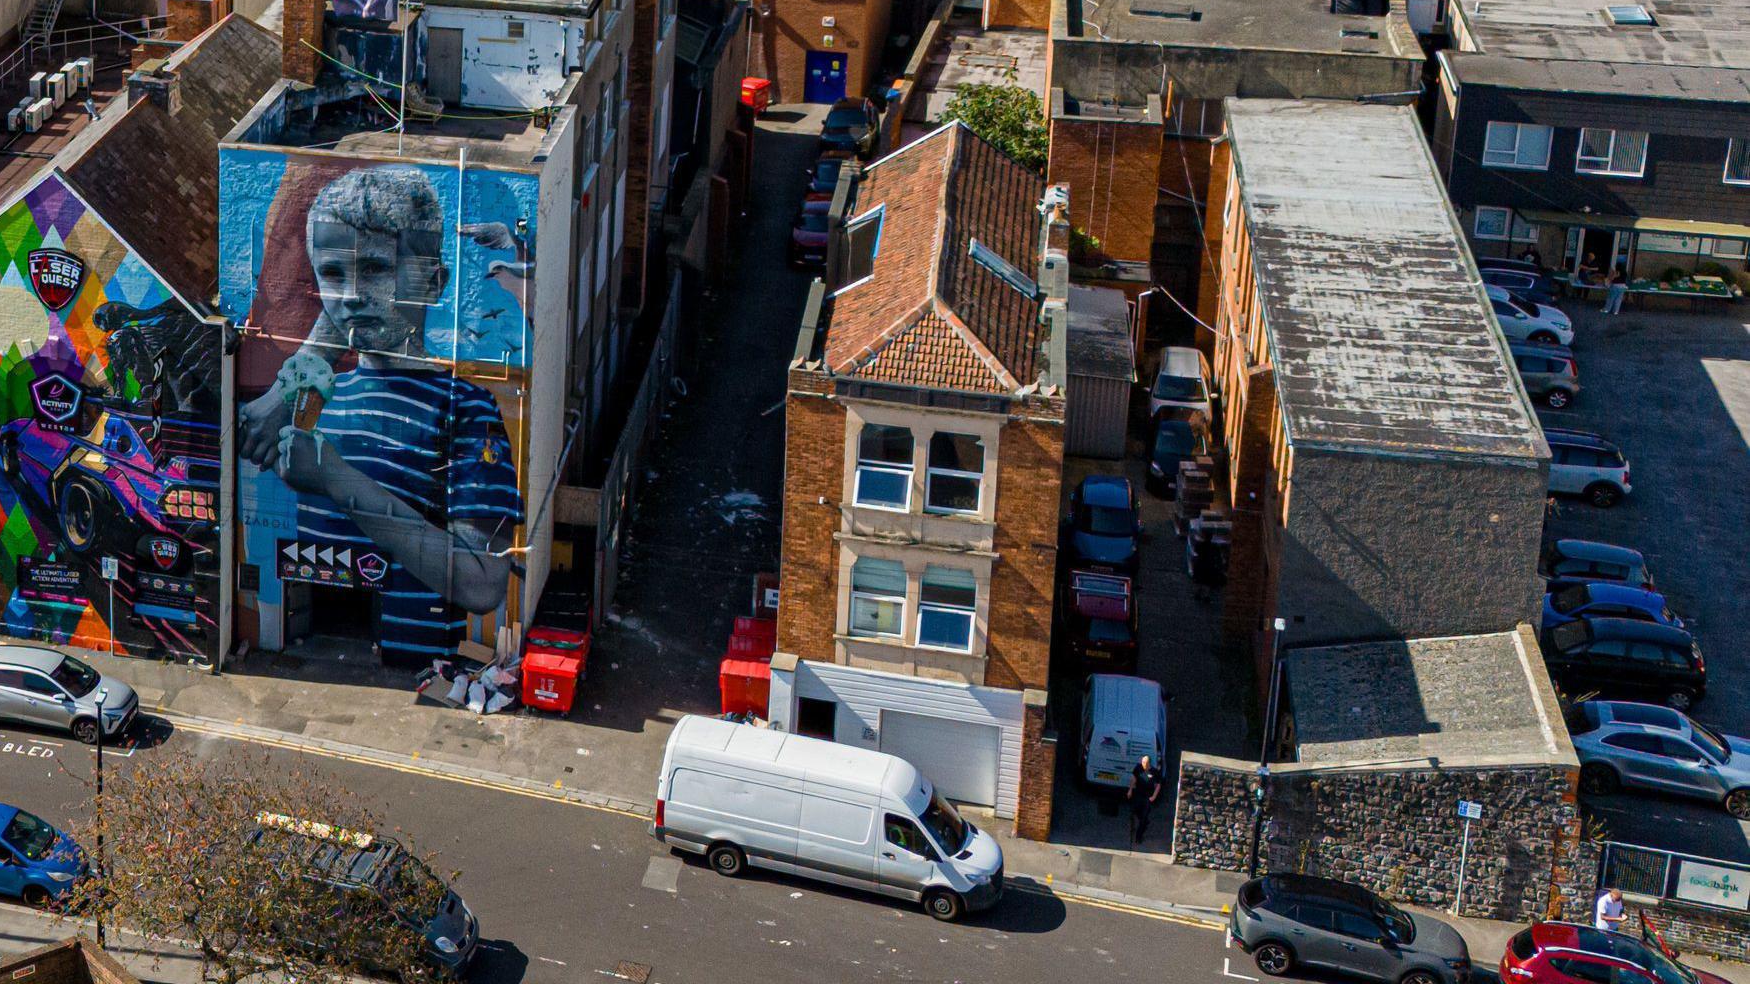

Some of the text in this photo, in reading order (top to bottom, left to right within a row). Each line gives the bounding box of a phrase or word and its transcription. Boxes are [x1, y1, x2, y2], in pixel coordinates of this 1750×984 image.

[41, 273, 78, 289] QUEST
[41, 399, 74, 409] ACTIVITY
[41, 423, 75, 432] WESTON
[244, 516, 290, 529] ZABOU
[51, 576, 80, 584] ADVENTURE
